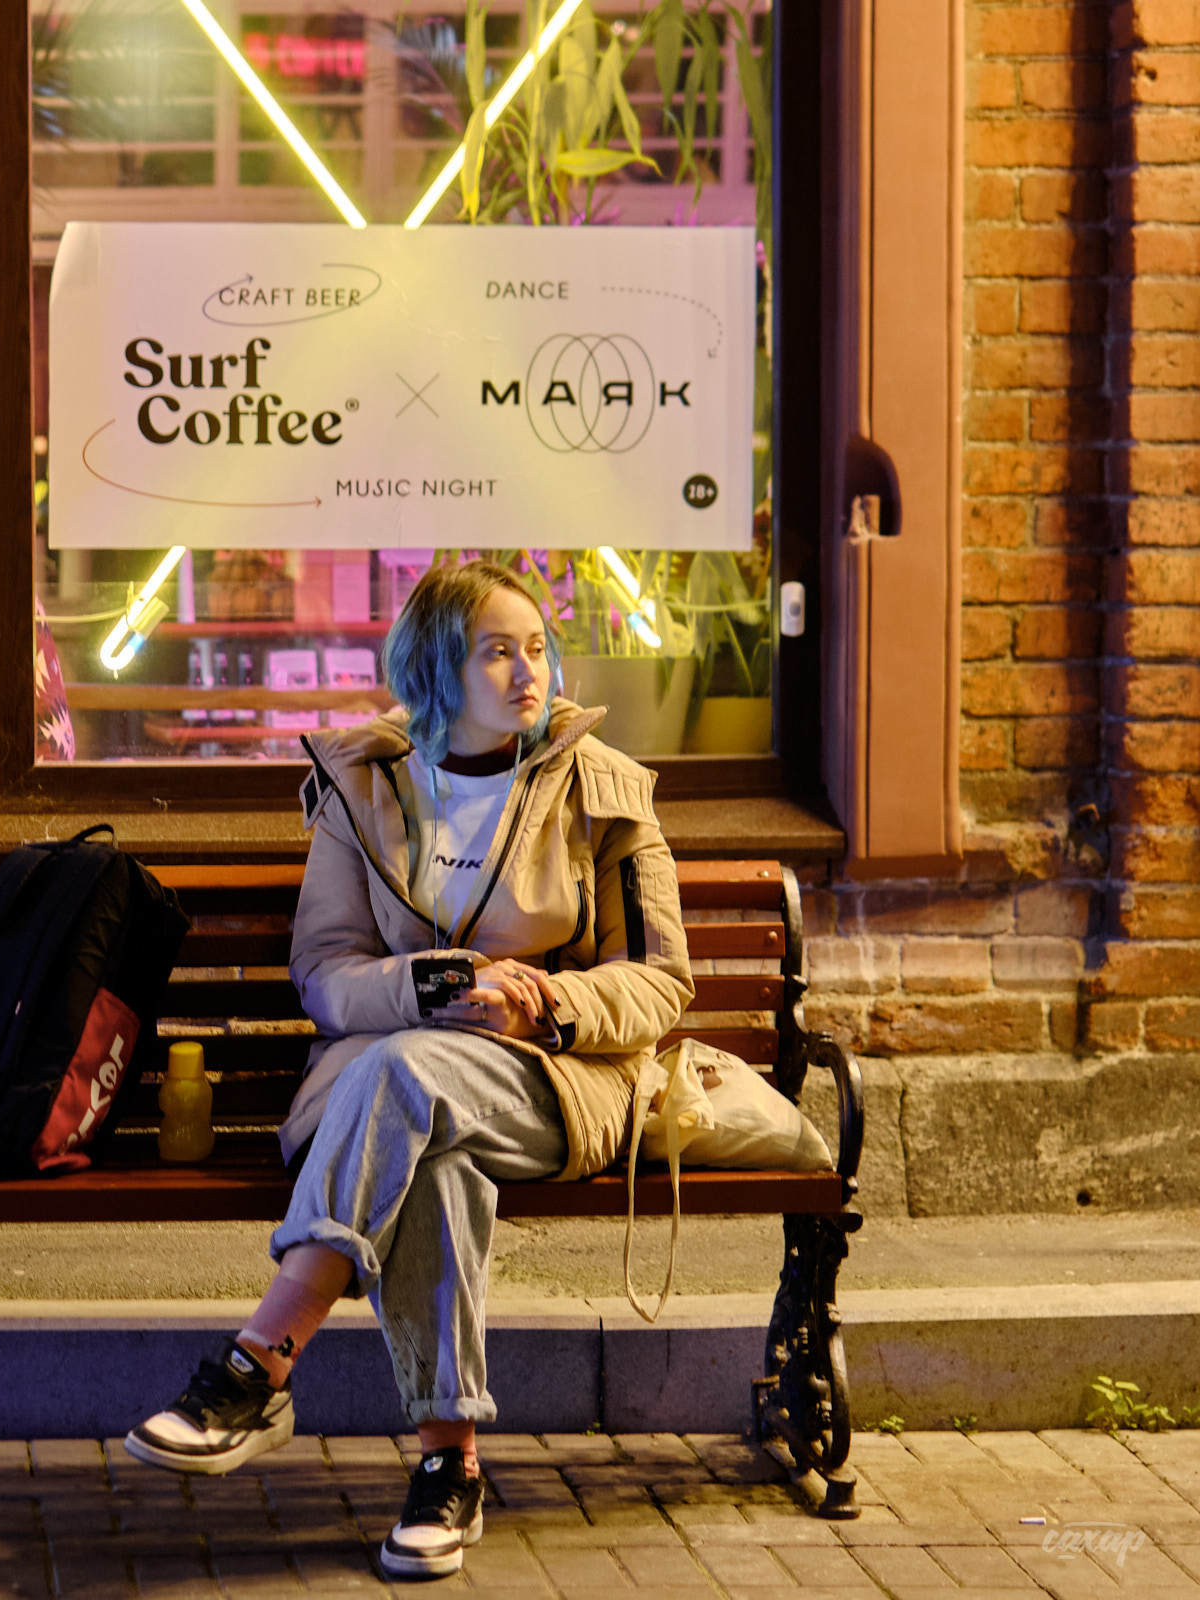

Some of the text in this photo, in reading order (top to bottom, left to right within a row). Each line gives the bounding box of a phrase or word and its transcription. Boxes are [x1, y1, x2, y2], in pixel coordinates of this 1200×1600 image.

[218, 287, 361, 307] CRAFT BEER
[485, 280, 569, 300] DANCE
[123, 337, 271, 389] Surf
[481, 379, 692, 407] МАЯК
[335, 479, 498, 497] MUSIC NIGHT
[432, 855, 484, 869] NIK
